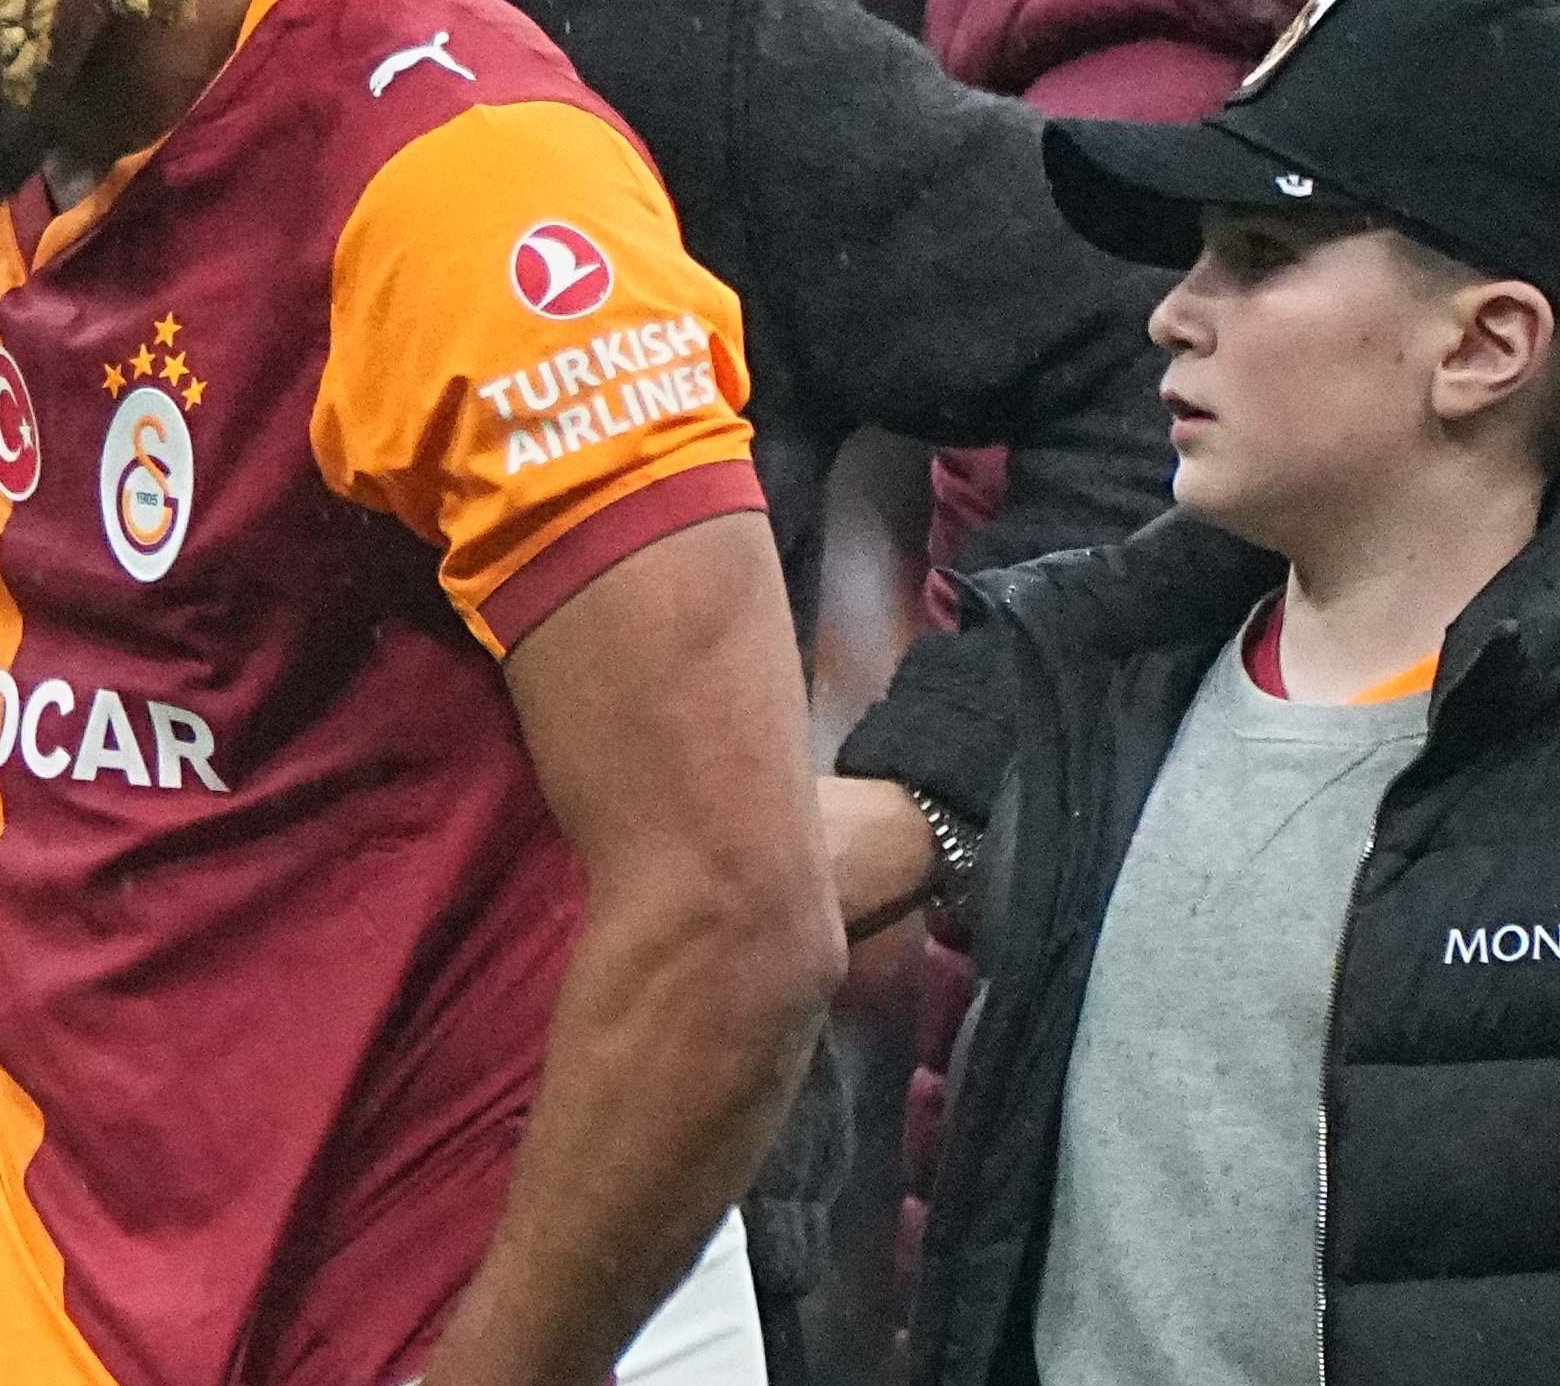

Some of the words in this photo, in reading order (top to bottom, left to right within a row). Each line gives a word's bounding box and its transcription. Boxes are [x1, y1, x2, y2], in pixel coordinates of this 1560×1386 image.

[479, 314, 708, 420] TURKISH
[507, 362, 716, 474] AIRLINES
[1444, 924, 1560, 964] MON
